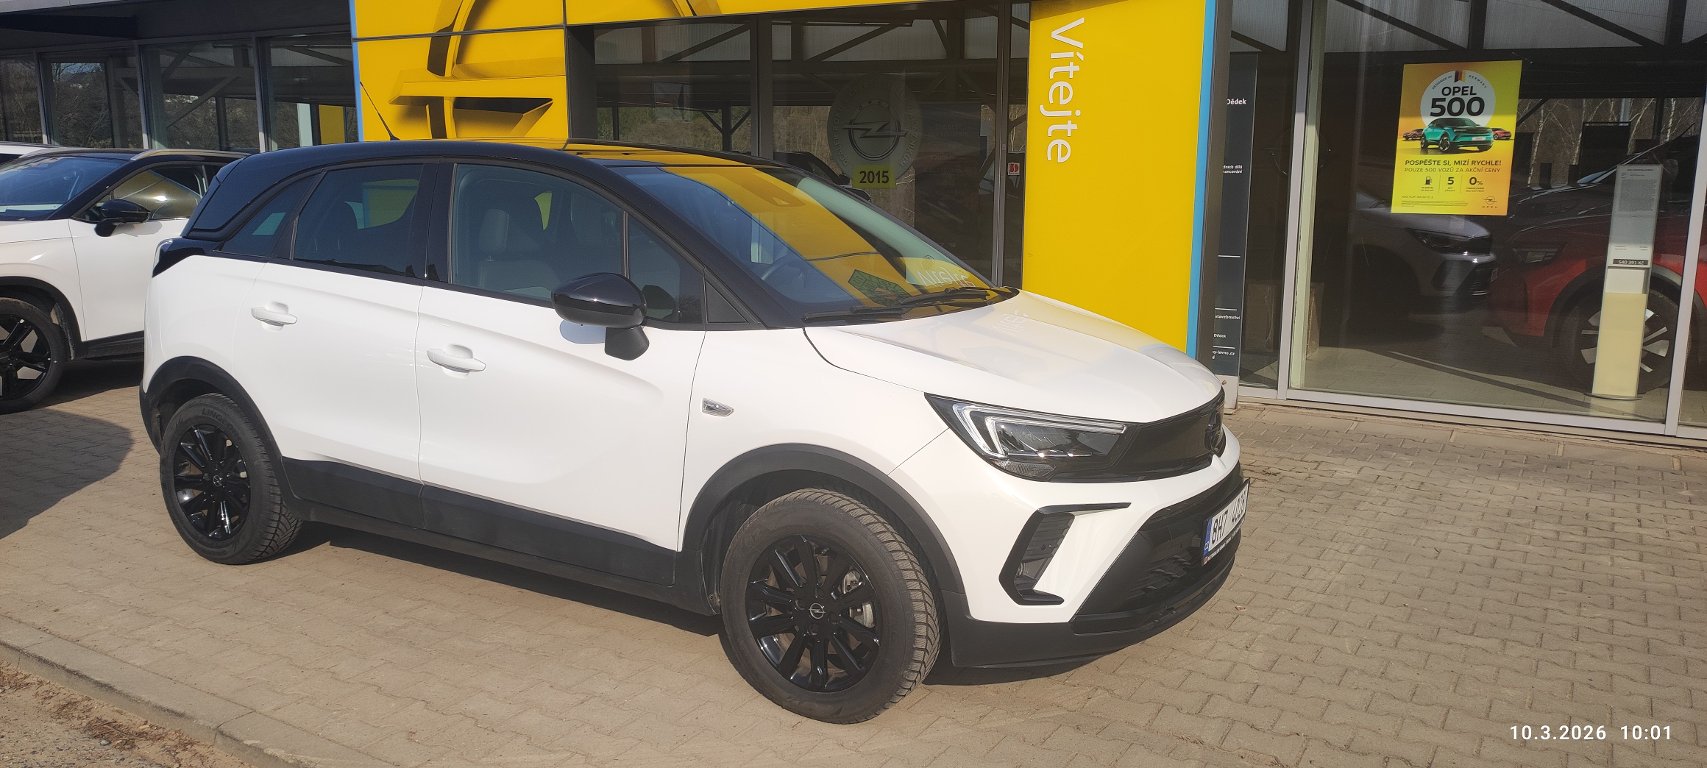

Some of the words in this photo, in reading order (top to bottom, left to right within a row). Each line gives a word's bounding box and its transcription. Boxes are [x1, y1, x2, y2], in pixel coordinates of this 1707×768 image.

[1040, 17, 1085, 163] Vítejte
[1441, 86, 1477, 96] OPEL
[1430, 97, 1485, 117] 500
[859, 170, 890, 184] 2015
[1447, 176, 1454, 185] 5
